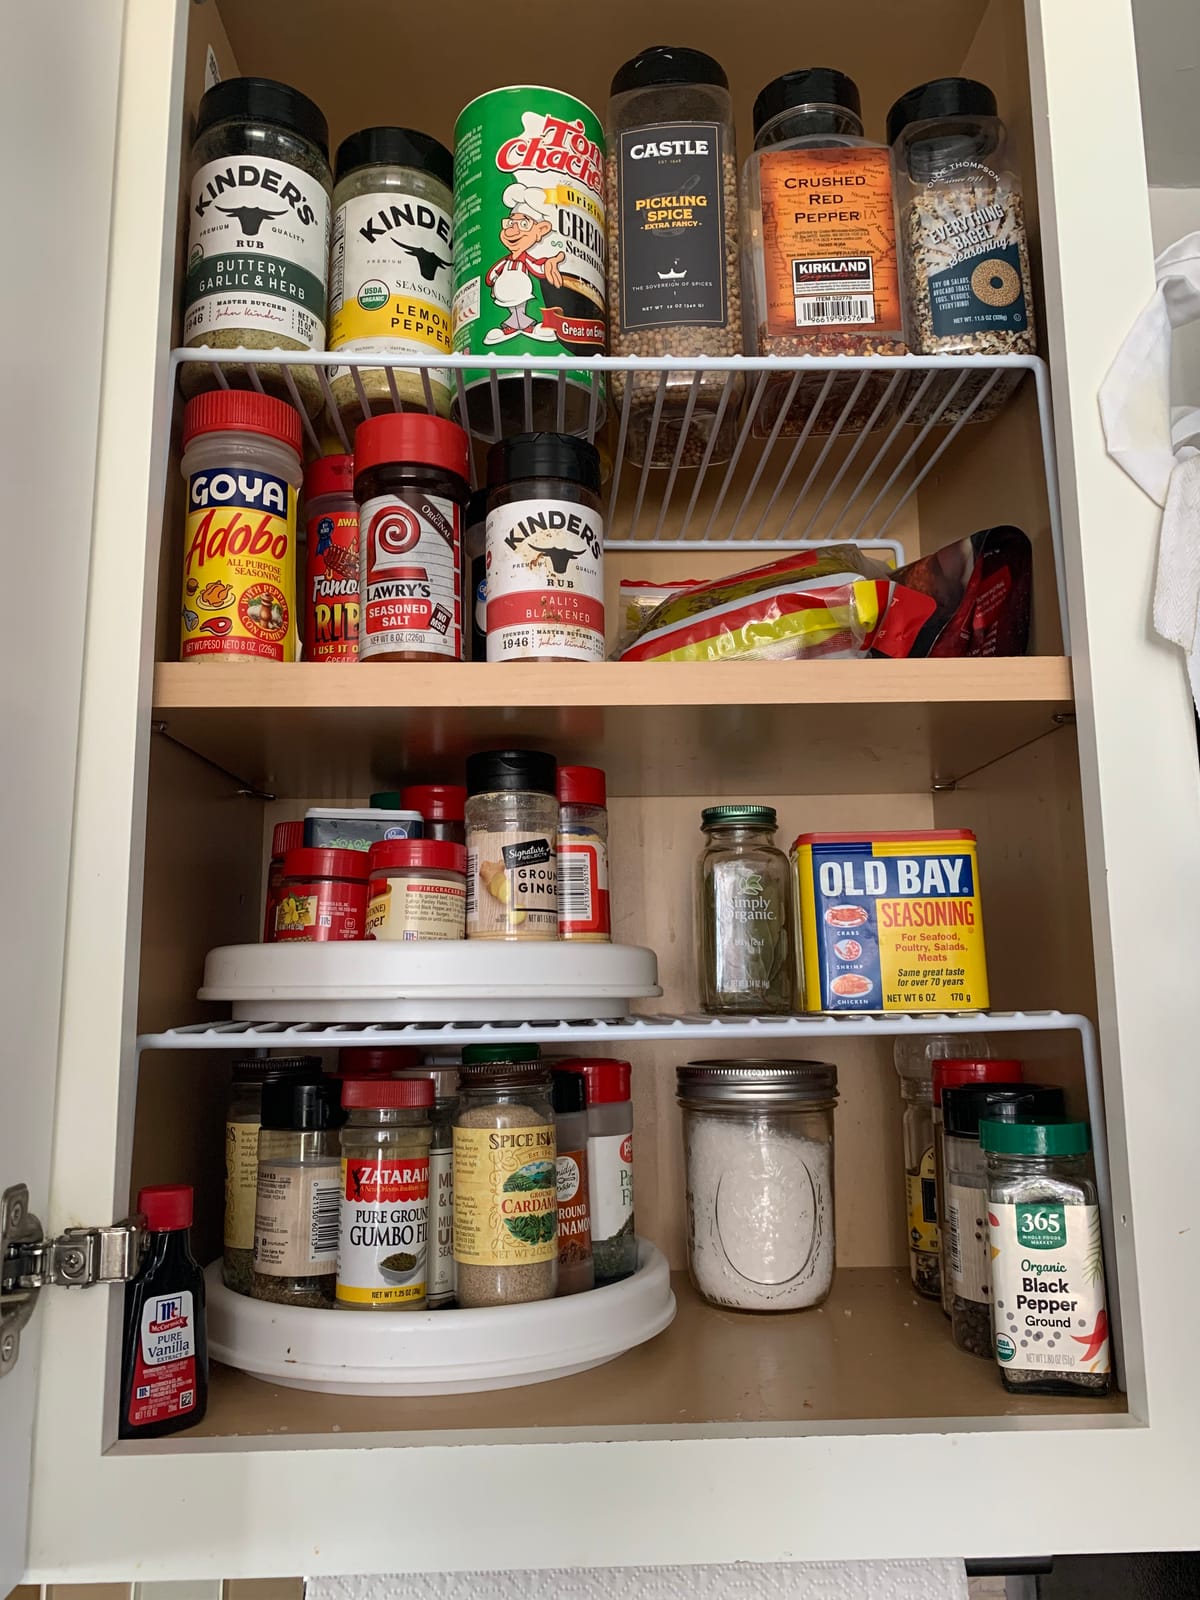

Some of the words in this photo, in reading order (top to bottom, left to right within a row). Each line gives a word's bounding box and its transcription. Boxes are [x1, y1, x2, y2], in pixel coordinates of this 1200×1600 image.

[543, 116, 602, 170] Ton
[630, 140, 709, 160] CASTLE
[497, 138, 604, 196] Chache
[950, 161, 1000, 182] THOMPSON
[785, 176, 866, 189] CRUSHED
[195, 166, 314, 225] KINDER'S
[635, 195, 707, 211] PICKLING
[809, 194, 843, 205] RED
[567, 191, 601, 221] Origin
[647, 209, 693, 222] SPICE
[795, 211, 860, 223] PEPPER
[359, 203, 453, 250] KINDE
[929, 204, 1004, 245] EVERYTHING
[199, 224, 230, 237] PREMIUM
[272, 227, 305, 244] QUALITY
[952, 225, 994, 251] BAGEL
[236, 240, 264, 249] RUB
[949, 238, 1010, 268] Seasoning
[217, 260, 286, 276] BUTTERY
[800, 262, 867, 274] KIRKLAND
[200, 273, 249, 292] GARLIC
[255, 275, 263, 286] &
[269, 278, 305, 300] HERB
[645, 282, 679, 290] SOVEREIGN
[251, 300, 286, 311] BUTCHER
[396, 303, 448, 331] LEMON
[391, 317, 451, 348] PEPPER
[562, 322, 584, 336] Great
[192, 474, 284, 512] GOYA
[338, 518, 360, 526] AWA
[421, 504, 452, 539] ORIGINAL
[185, 509, 288, 576] Adobo
[504, 511, 601, 560] KINDER'S
[226, 558, 243, 567] ALL
[245, 559, 282, 576] PURPOSE
[575, 565, 598, 576] QUALITY
[234, 567, 281, 584] SEASONING
[547, 579, 574, 588] RUB
[312, 575, 360, 602] Famo
[367, 583, 431, 601] LAWRY'S
[241, 585, 262, 605] WITH
[263, 585, 288, 612] PEPPER
[369, 604, 428, 618] SEASONED
[436, 611, 447, 622] NO
[526, 609, 590, 623] BLAKENED
[242, 615, 258, 637] CON
[315, 602, 359, 641] RIB
[382, 616, 410, 627] SALT
[430, 619, 446, 633] MSG
[390, 633, 395, 641] 8
[395, 633, 403, 641] OZ
[405, 633, 426, 643] (226g)
[502, 630, 530, 639] FOUNDED
[222, 640, 239, 649] NETO
[241, 641, 245, 650] 8
[259, 644, 276, 656] (226g)
[318, 646, 334, 654] USE
[338, 644, 347, 653] IT
[503, 637, 529, 650] 1946
[509, 846, 544, 860] Signature
[819, 861, 887, 897] OLD
[897, 859, 963, 895] BAY
[518, 883, 557, 895] GINGE
[881, 900, 974, 927] SEASONING
[901, 933, 916, 941] For
[920, 933, 960, 941] Seafood,
[895, 943, 931, 953] Poultry,
[934, 943, 968, 952] Salads,
[918, 953, 947, 962] Meats
[897, 968, 920, 977] Same
[922, 968, 943, 979] great
[945, 968, 965, 976] taste
[897, 978, 908, 987] for
[910, 978, 928, 986] over
[930, 977, 940, 986] 70
[942, 978, 964, 988] years
[887, 994, 902, 1003] NET
[904, 994, 916, 1002] WT
[918, 994, 924, 1002] 6
[950, 993, 963, 1001] 170
[965, 995, 971, 1003] g
[489, 1133, 533, 1150] SPICE
[360, 1168, 430, 1184] ZATARAIN
[439, 1193, 446, 1207] &
[501, 1196, 557, 1214] CARDAM
[356, 1210, 387, 1223] PURE
[391, 1206, 428, 1223] GROUN
[559, 1204, 586, 1219] ROUND
[1022, 1211, 1060, 1233] 365
[350, 1225, 413, 1246] GUMBO
[416, 1222, 427, 1243] FIL
[492, 1250, 510, 1258] NET
[515, 1249, 529, 1258] WT
[1021, 1259, 1067, 1276] Organic
[1023, 1278, 1069, 1293] Black
[1017, 1295, 1077, 1314] Pepper
[1025, 1315, 1071, 1328] Ground
[158, 1331, 182, 1344] PURE
[148, 1340, 190, 1358] Vanilla
[157, 1352, 182, 1362] EXTRACT
